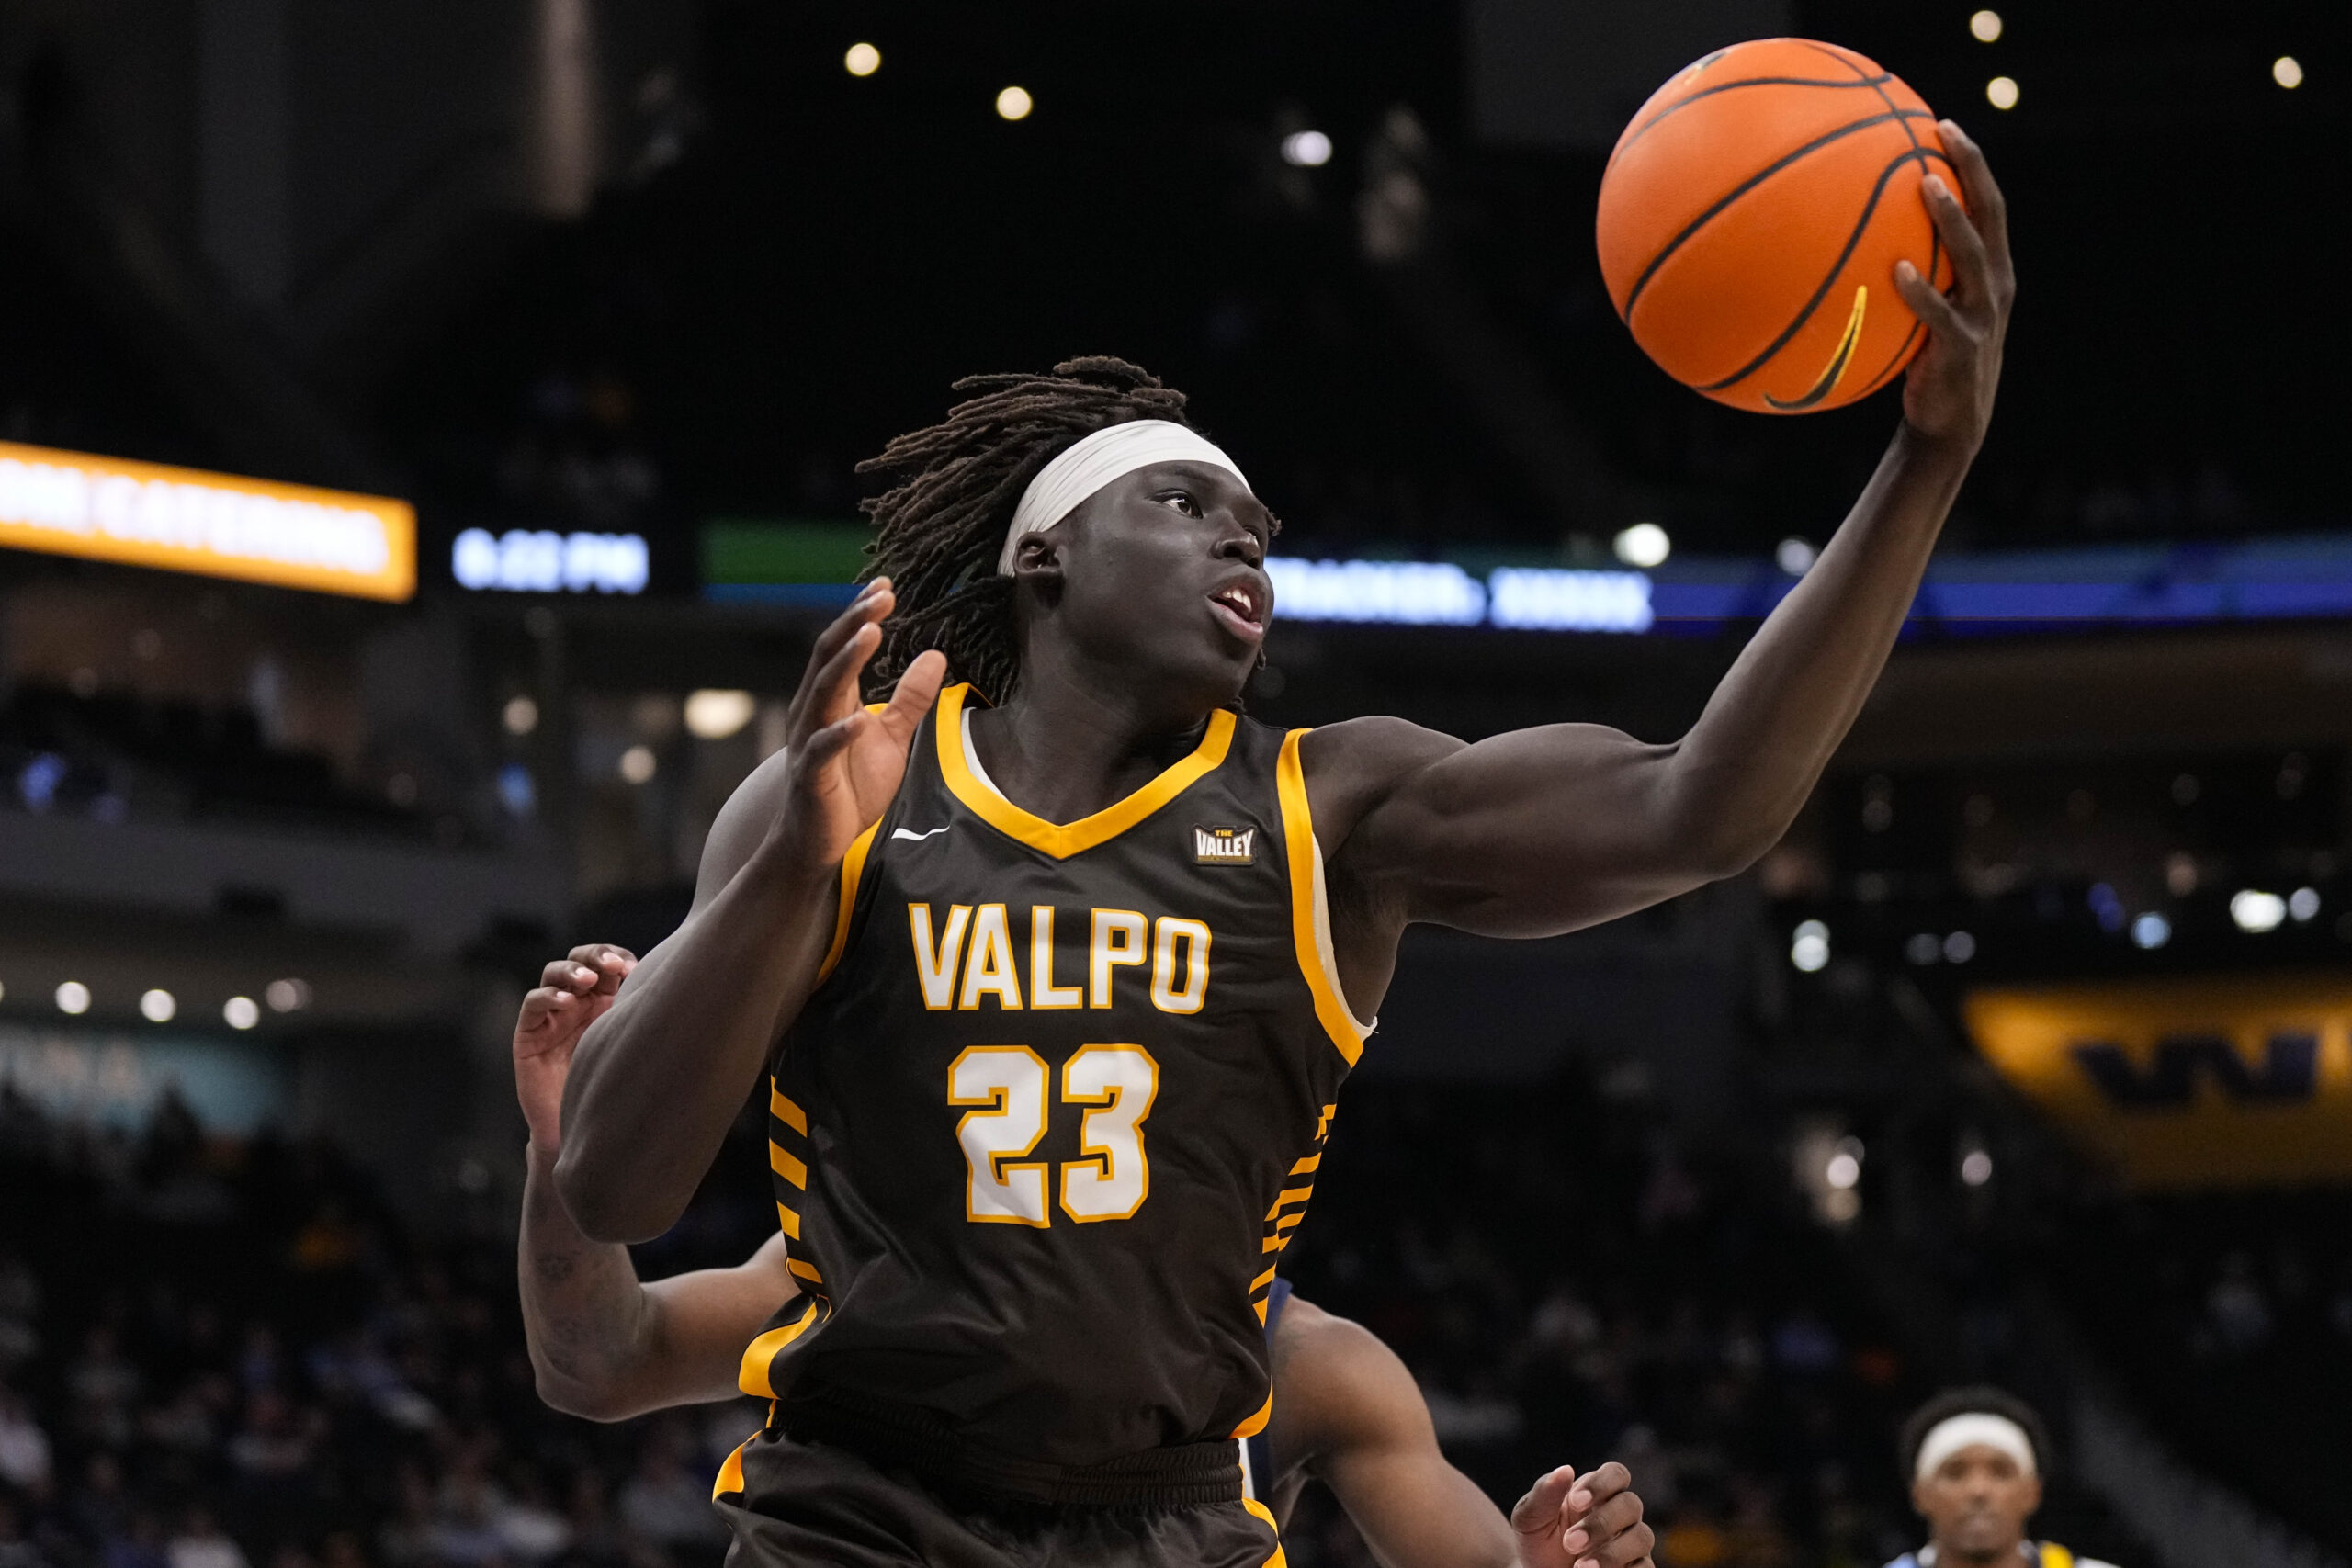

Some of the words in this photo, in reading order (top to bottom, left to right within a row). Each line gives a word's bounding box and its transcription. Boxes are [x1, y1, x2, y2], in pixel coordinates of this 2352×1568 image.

[1195, 829, 1254, 856] VALLEY
[908, 903, 1212, 1014] VALPO
[947, 1043, 1159, 1228] 23
